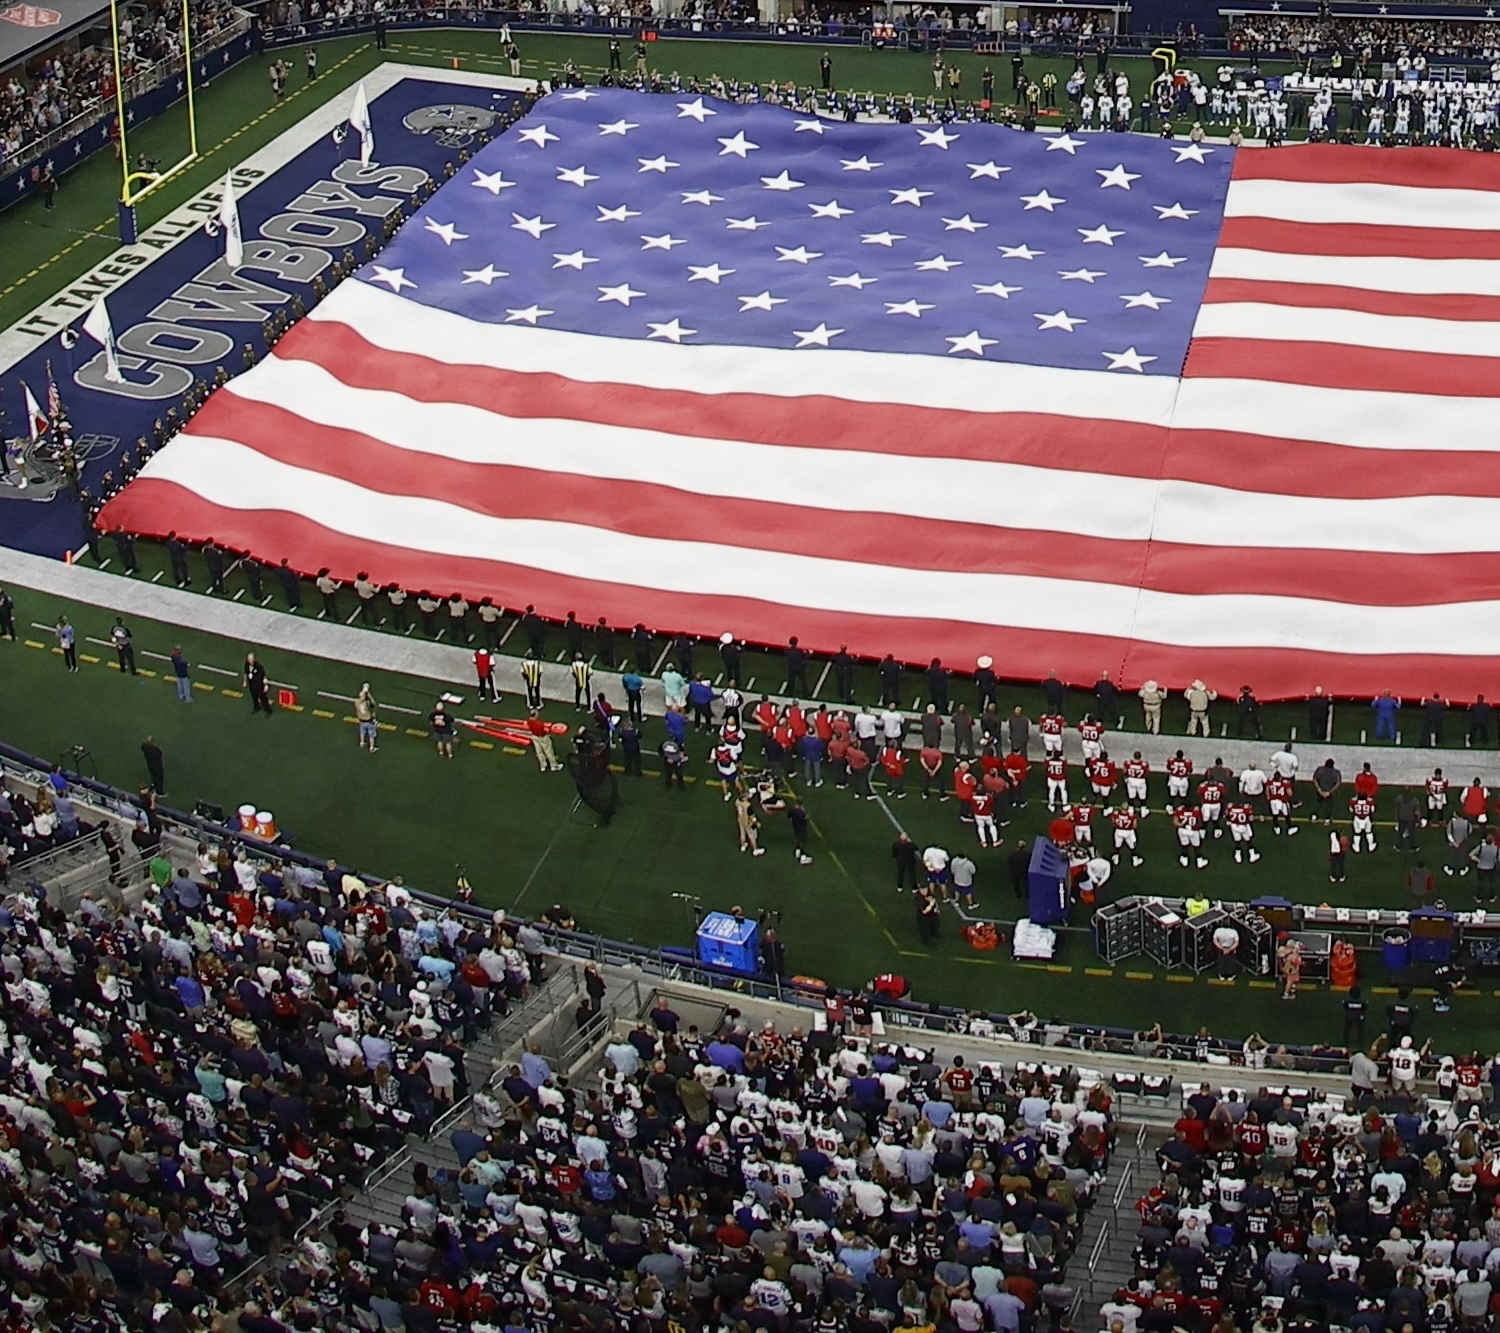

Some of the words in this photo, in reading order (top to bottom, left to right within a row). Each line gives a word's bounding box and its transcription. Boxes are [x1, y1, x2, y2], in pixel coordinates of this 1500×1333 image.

[17, 314, 59, 338] IT
[52, 253, 146, 309] TAKES
[142, 219, 201, 249] ALL
[187, 192, 224, 213] OF
[226, 167, 266, 188] US
[73, 157, 432, 400] COWBOYS
[1044, 724, 1059, 732] 72
[1093, 767, 1108, 777] 76
[1171, 766, 1186, 775] 73
[977, 801, 984, 810] 7
[1081, 813, 1088, 821] 3
[1231, 813, 1246, 822] 70
[312, 953, 324, 965] 11
[689, 1049, 698, 1060] 4
[1395, 1059, 1410, 1069] 12
[749, 1103, 757, 1114] 4
[1317, 1113, 1325, 1123] 4
[1242, 1132, 1260, 1144] 40
[1311, 1148, 1318, 1157] 7
[1250, 1222, 1265, 1232] 21
[923, 1247, 942, 1259] 12
[760, 1294, 779, 1306] 12
